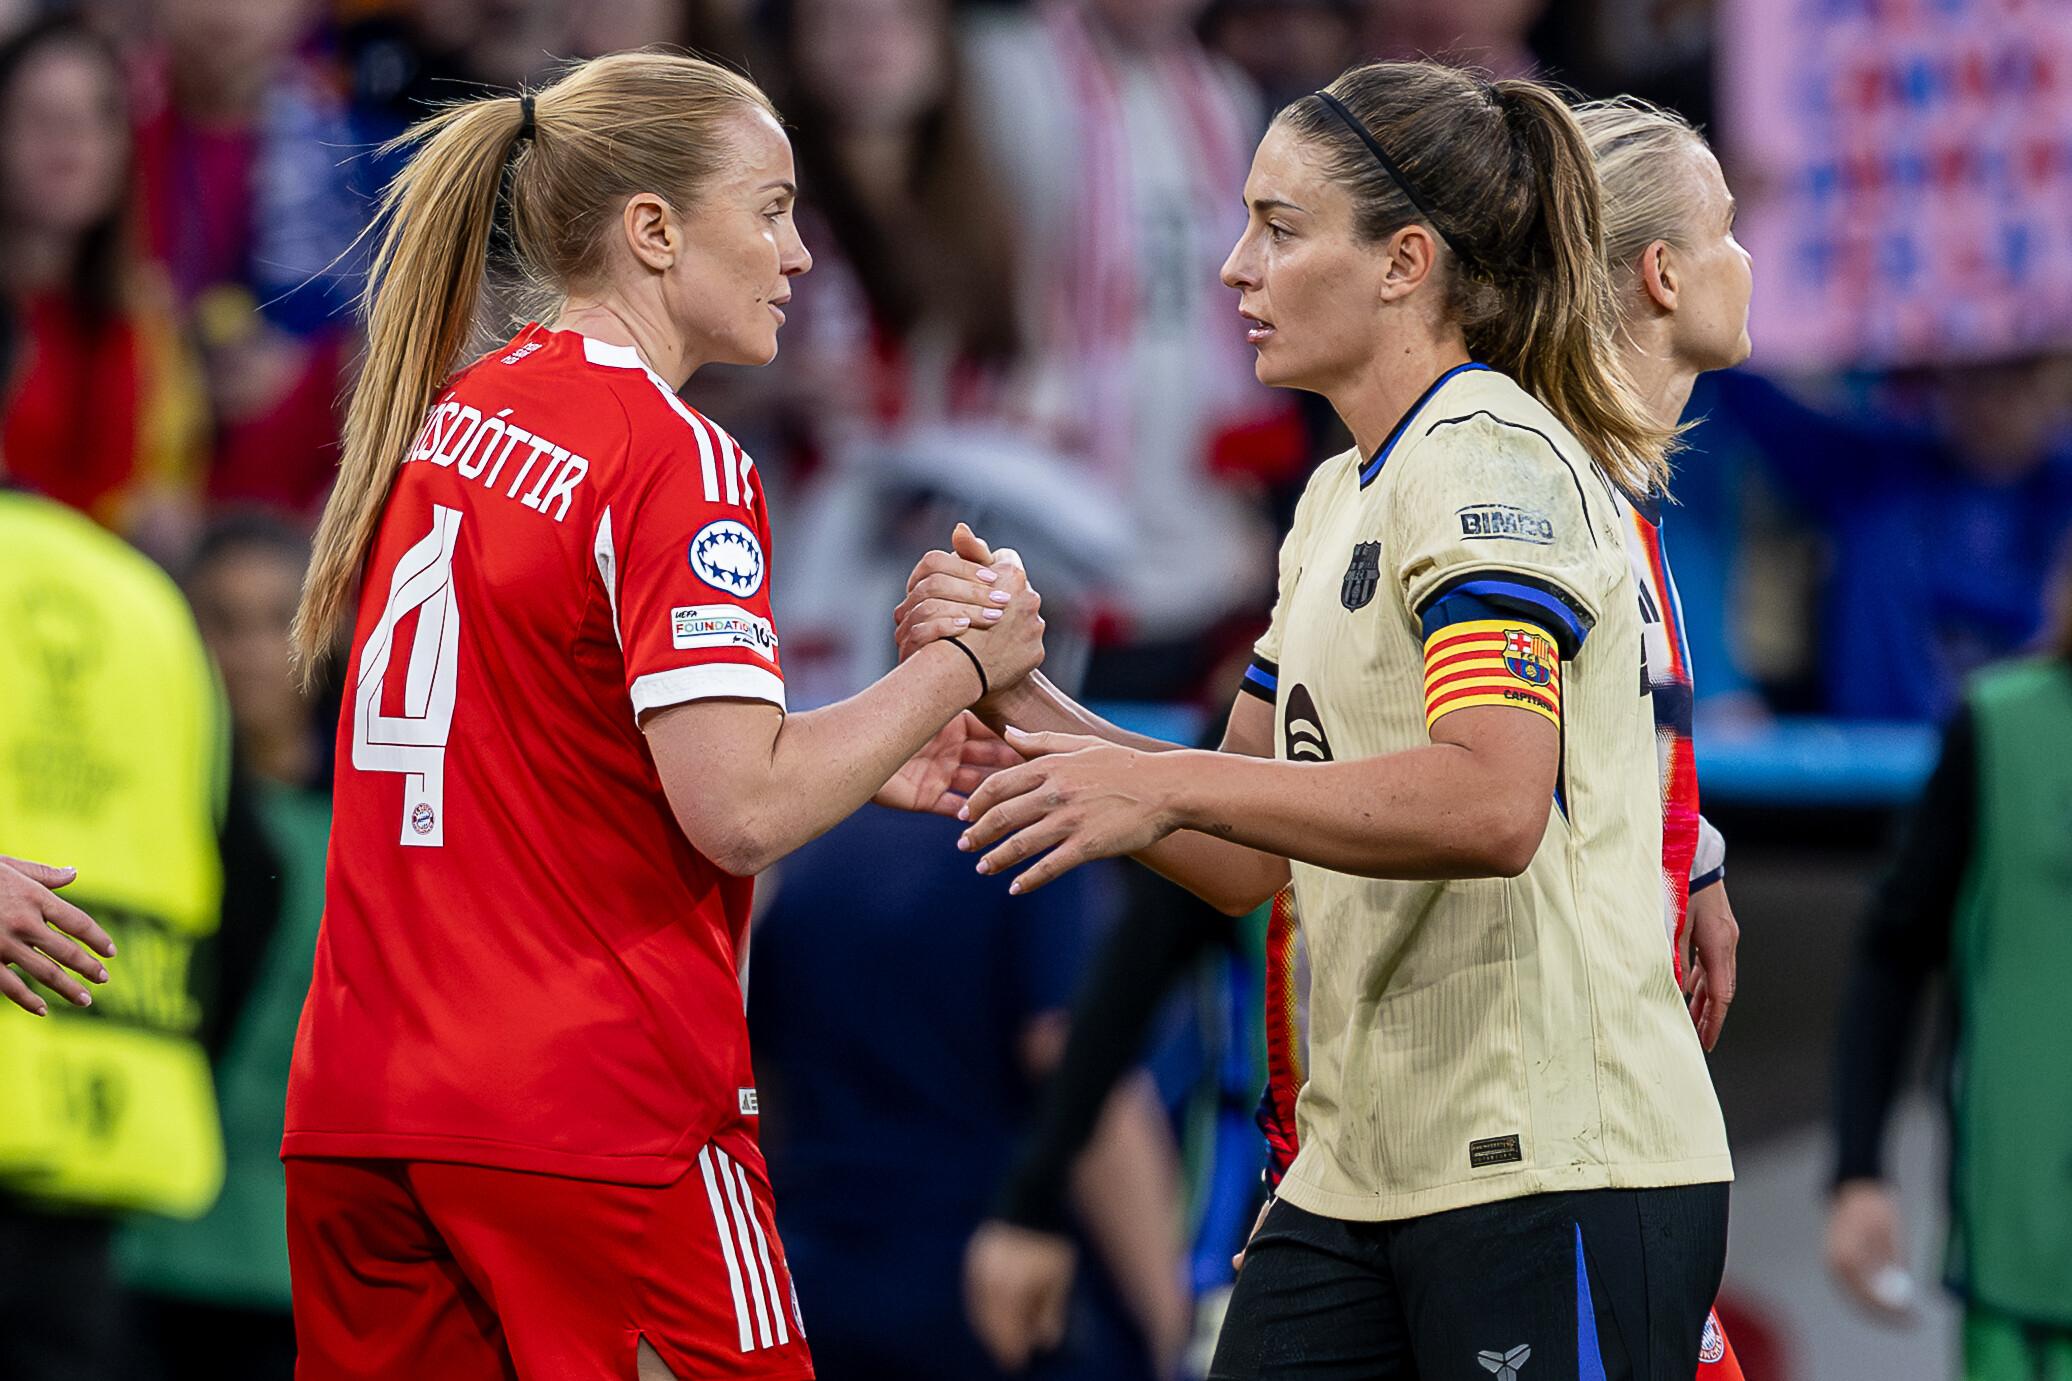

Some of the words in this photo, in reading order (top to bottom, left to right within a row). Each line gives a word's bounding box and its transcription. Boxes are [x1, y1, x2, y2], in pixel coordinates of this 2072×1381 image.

[403, 391, 589, 523] ÓSDÓTTIR
[352, 503, 464, 847] 4
[675, 610, 698, 619] UEFA
